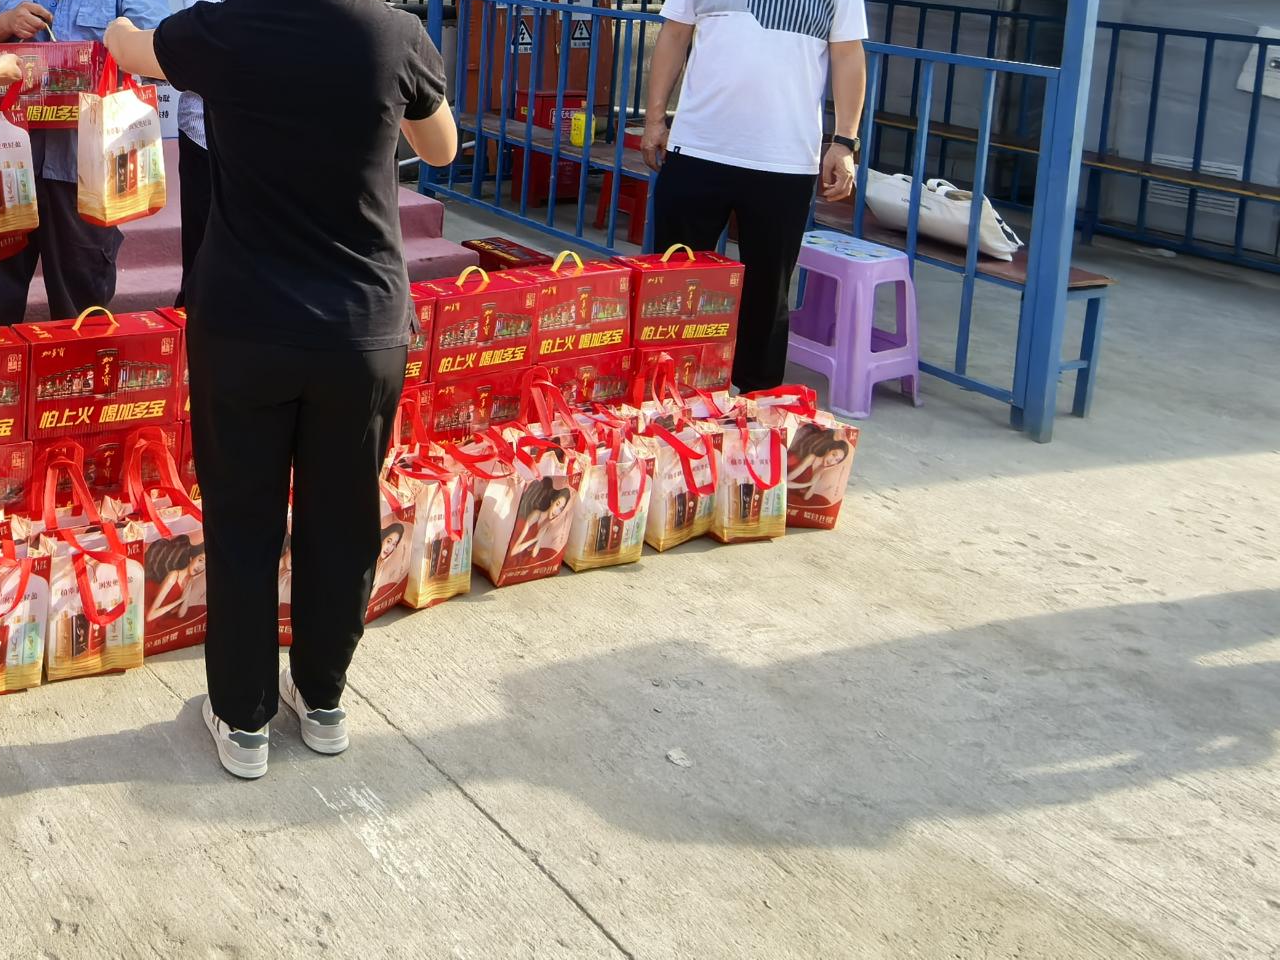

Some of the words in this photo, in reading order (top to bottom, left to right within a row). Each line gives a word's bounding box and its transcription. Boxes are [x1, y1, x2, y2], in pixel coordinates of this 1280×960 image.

[539, 335, 576, 355] 怕上火
[578, 328, 624, 350] 喝加多宝
[640, 324, 679, 341] 怕上火
[681, 323, 730, 339] 喝加多宝
[437, 352, 477, 374] 怕上火
[479, 345, 527, 367] 喝加多宝
[38, 406, 95, 429] 怕上火
[98, 399, 167, 424] 喝加多宝
